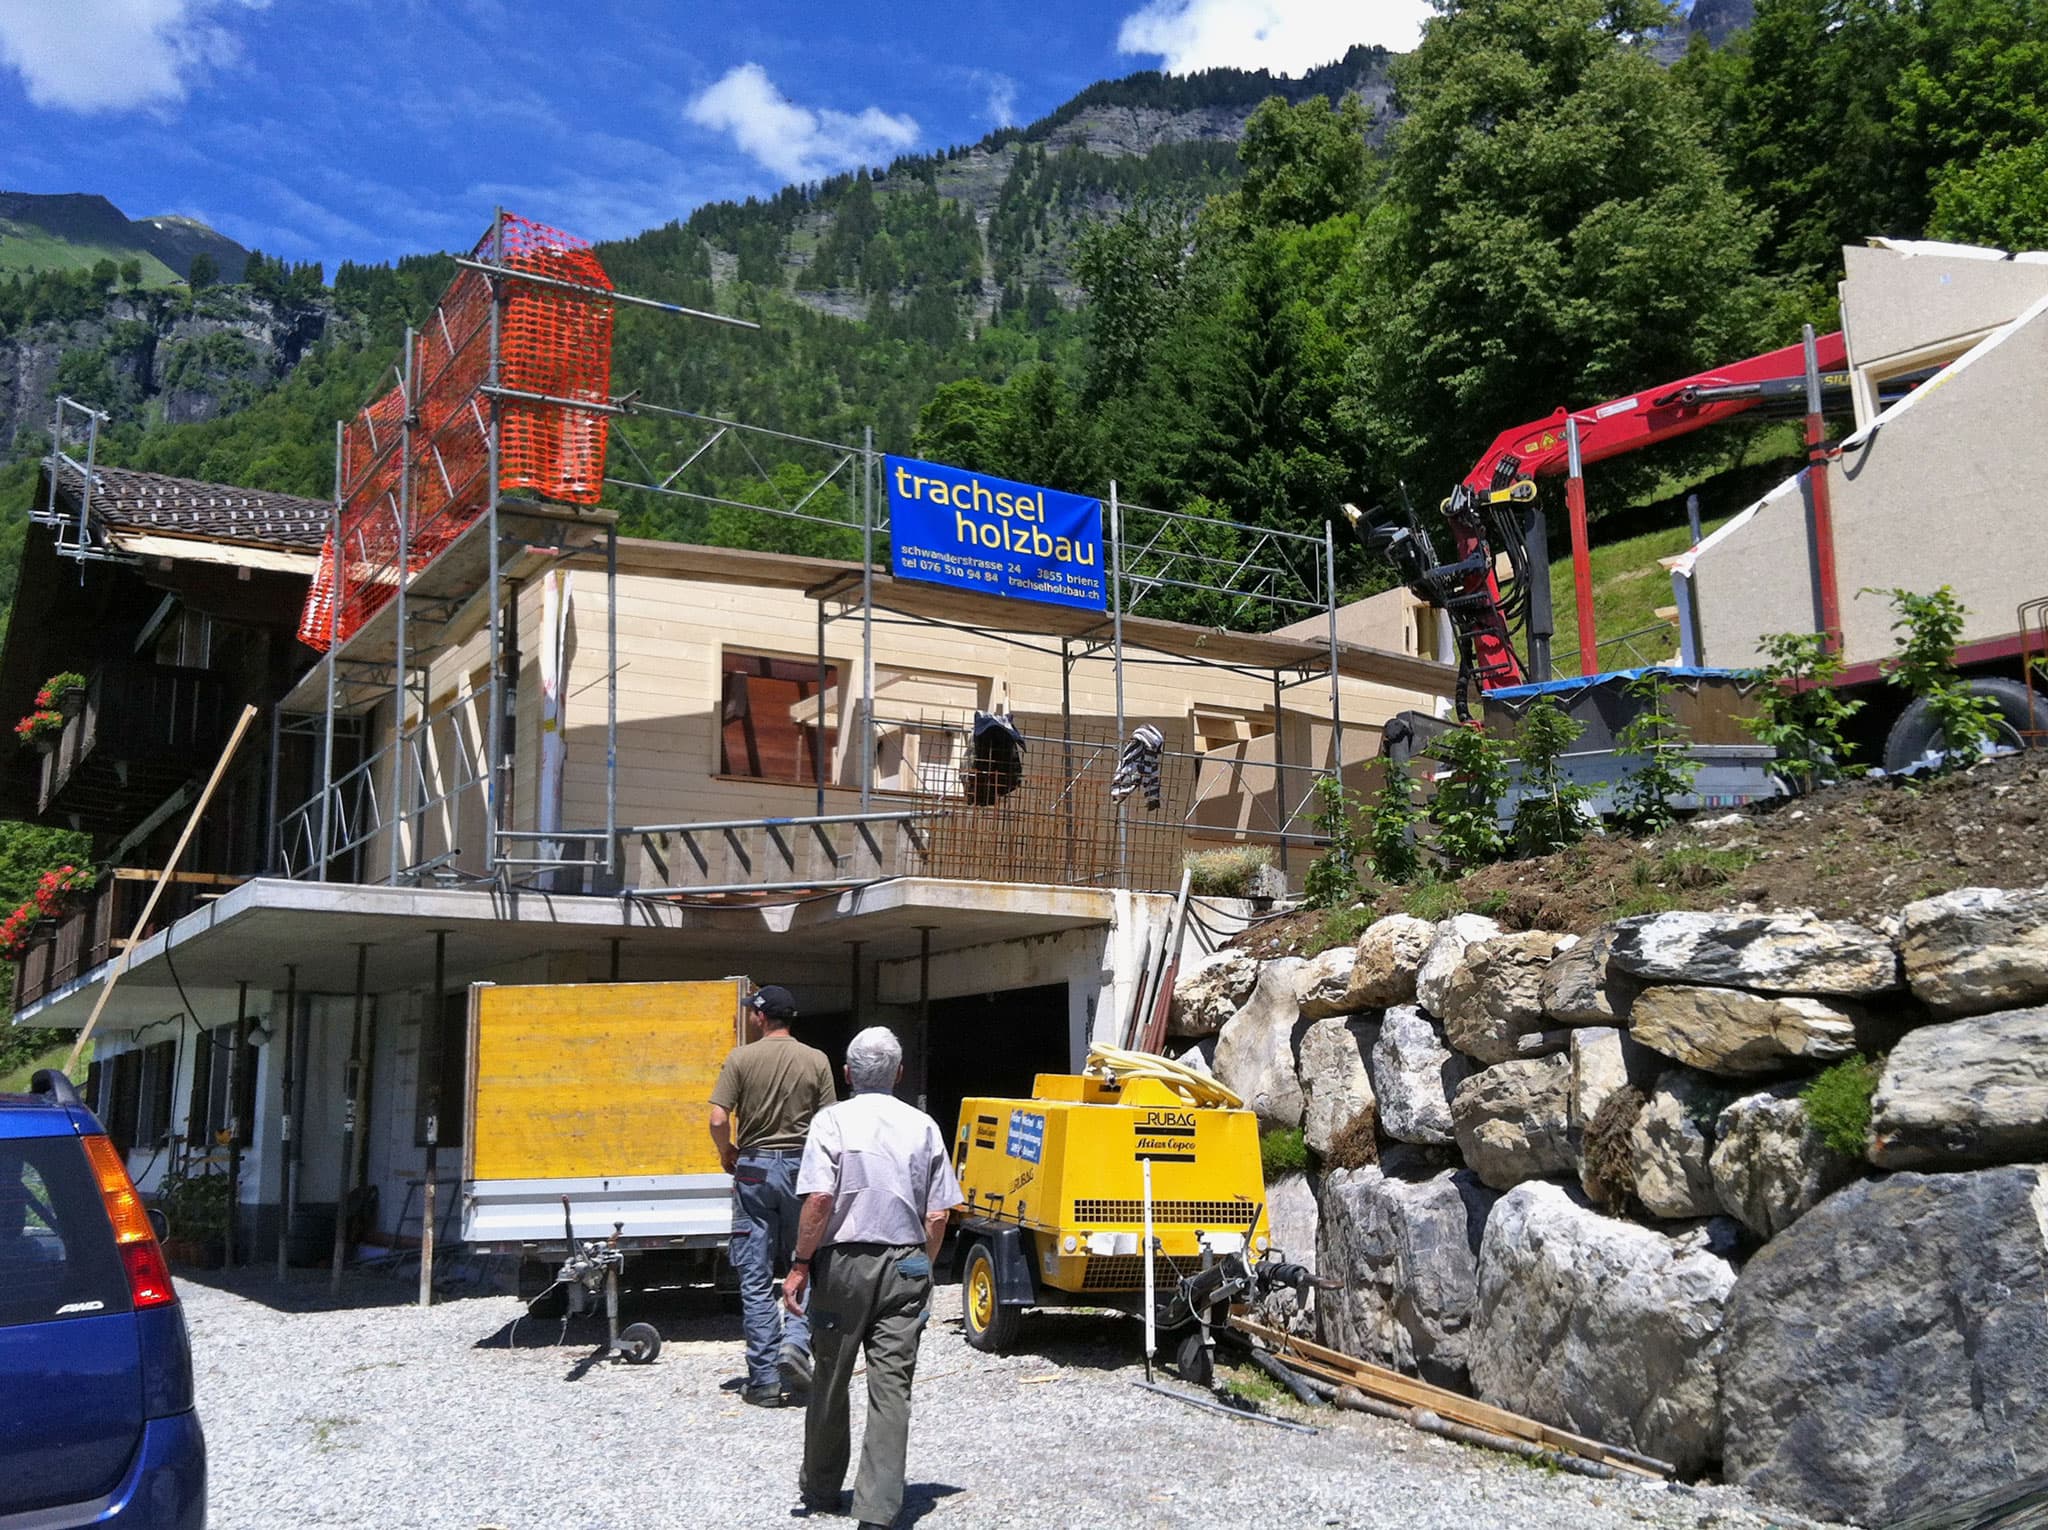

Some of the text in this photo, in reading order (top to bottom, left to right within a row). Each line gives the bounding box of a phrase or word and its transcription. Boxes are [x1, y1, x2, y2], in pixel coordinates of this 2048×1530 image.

[896, 466, 1044, 523] trachsel
[956, 511, 1094, 565] holzbau
[901, 545, 1099, 588] schwanderstrasse 24 3855 brienz
[901, 557, 1100, 600] tel 076 510 94 84 trachselholzbau.ch
[1140, 1112, 1196, 1126] RUBAG
[1168, 1138, 1196, 1152] Copco
[55, 1301, 105, 1314] AWD
